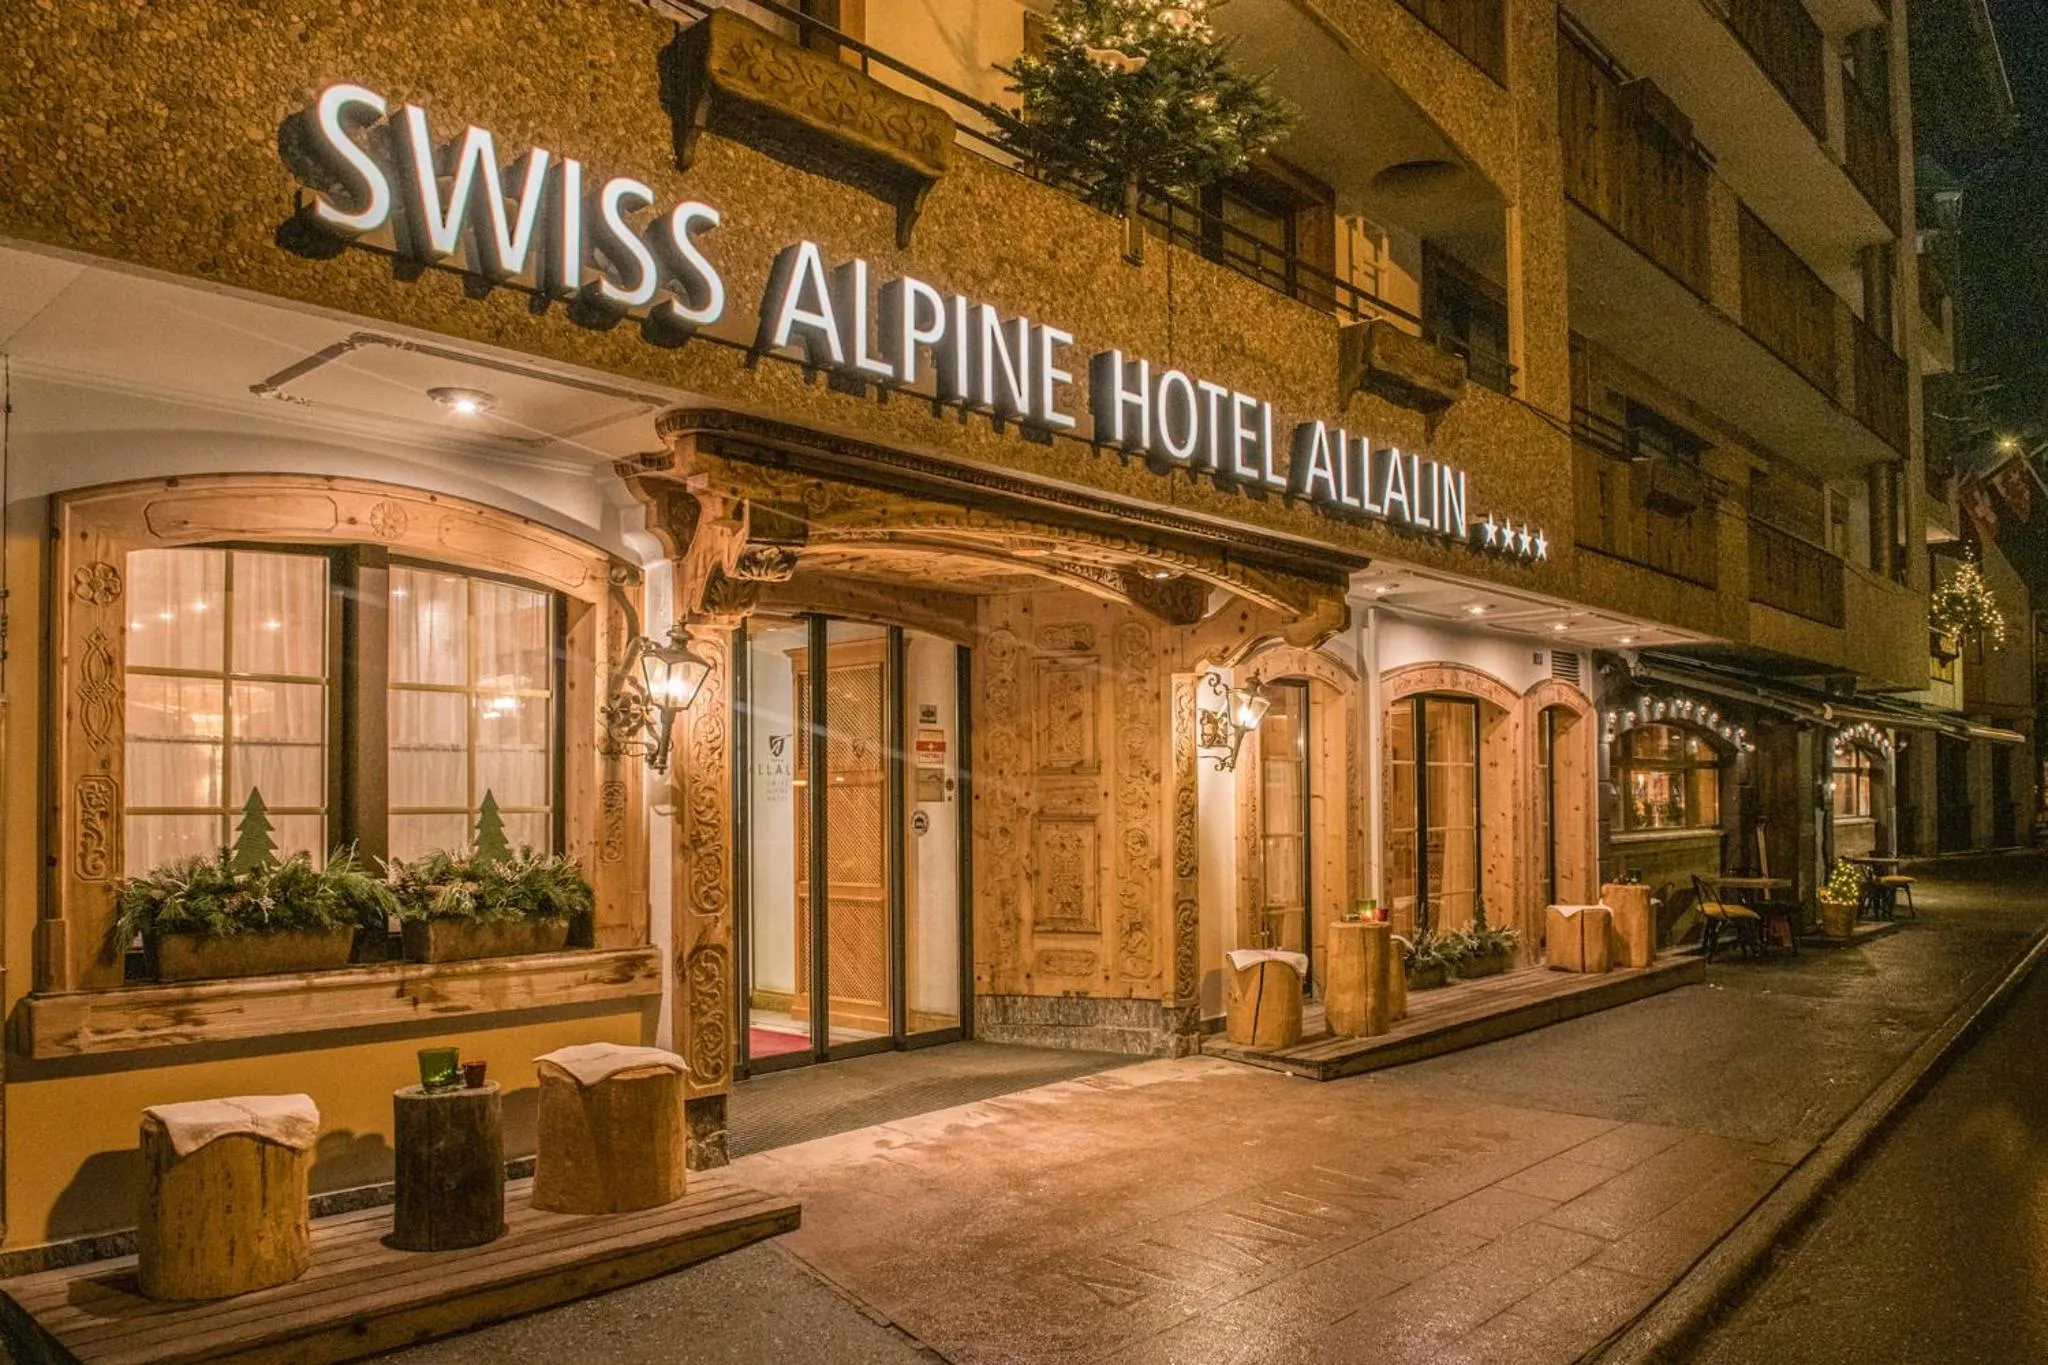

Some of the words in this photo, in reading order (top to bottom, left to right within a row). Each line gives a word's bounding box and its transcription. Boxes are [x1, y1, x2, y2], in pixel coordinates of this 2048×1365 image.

[316, 83, 725, 325] SWISS
[774, 240, 1076, 428] ALPINE
[1113, 349, 1288, 487] HOTEL
[1304, 420, 1467, 538] ALLALIN
